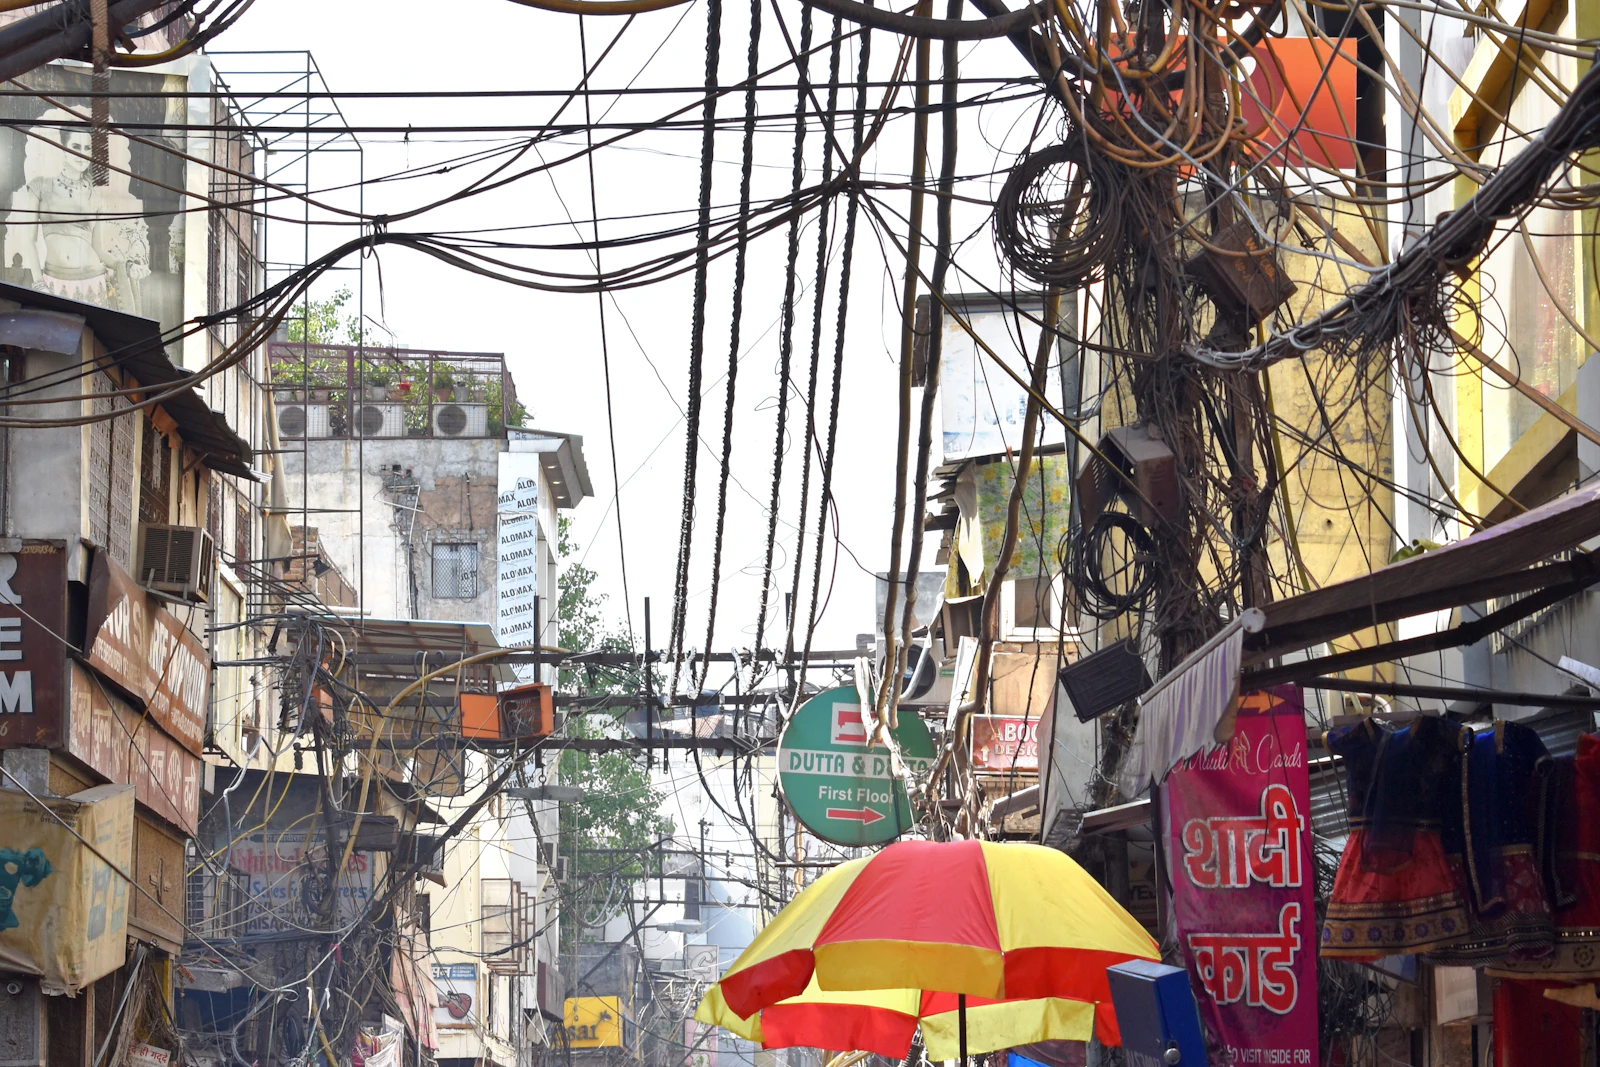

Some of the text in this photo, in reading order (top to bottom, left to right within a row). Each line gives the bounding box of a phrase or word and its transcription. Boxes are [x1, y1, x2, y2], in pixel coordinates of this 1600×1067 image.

[501, 530, 533, 544] ALOMAX
[501, 548, 533, 562] ALOMAX
[501, 566, 533, 581] ALOMAX
[501, 584, 533, 599] ALOMAX
[1257, 734, 1302, 773] Cards
[789, 752, 845, 774] DUTTA
[851, 756, 866, 775] &
[818, 785, 896, 803] First Floor
[1182, 784, 1304, 888] शादी
[1187, 902, 1300, 1015] कार्ड
[1240, 1047, 1262, 1063] VISIT
[1263, 1048, 1292, 1064] INSIDE
[1293, 1048, 1311, 1065] FOR
